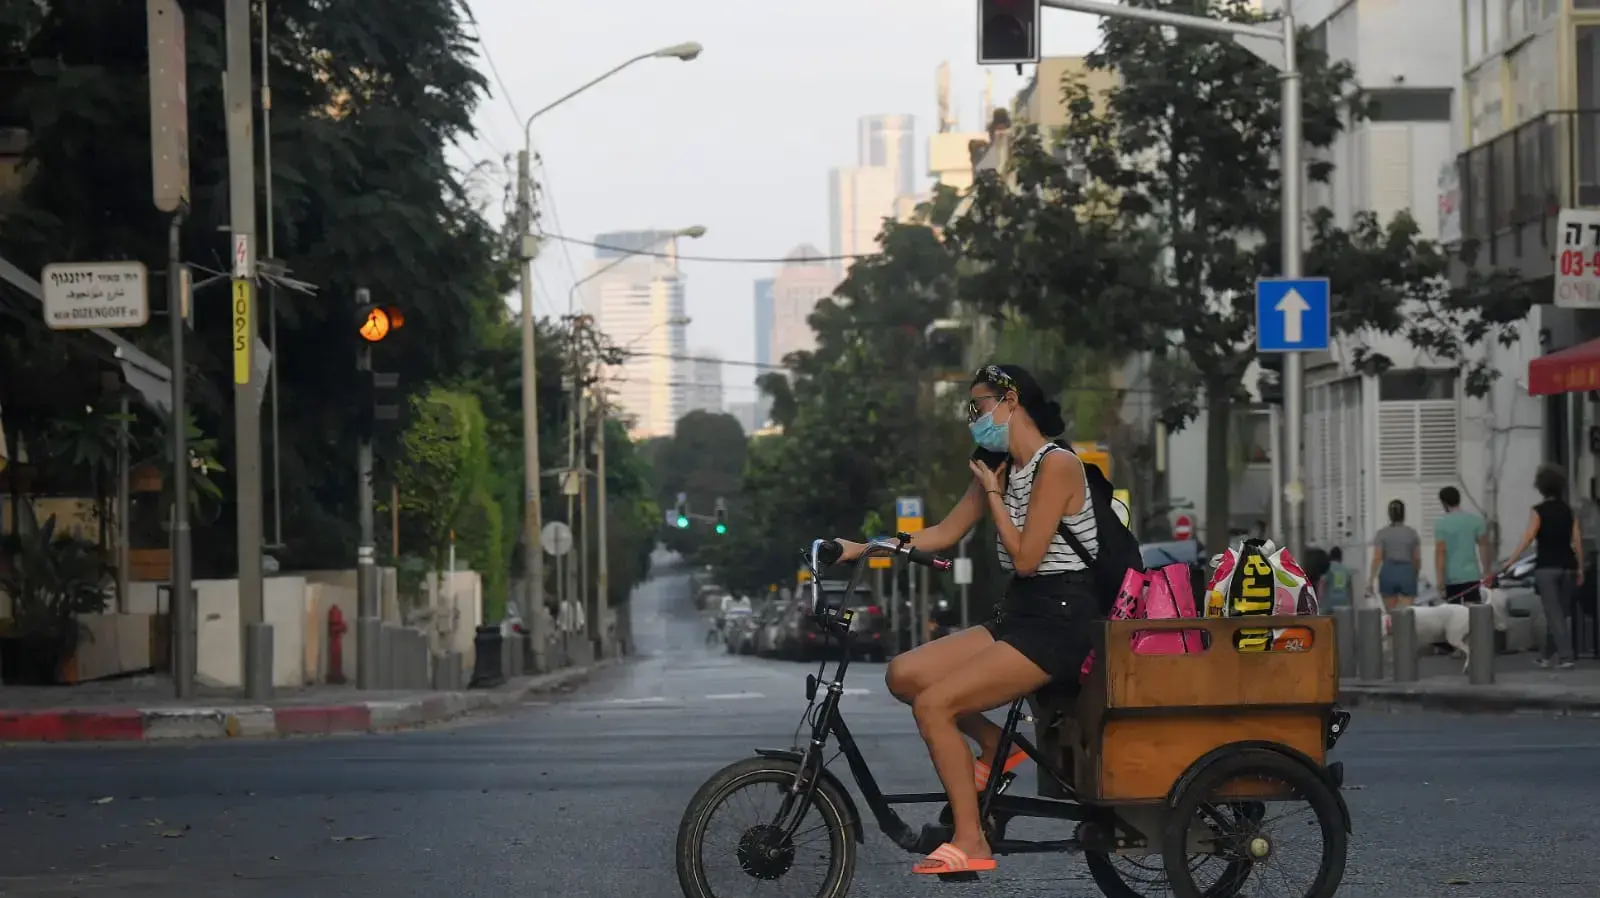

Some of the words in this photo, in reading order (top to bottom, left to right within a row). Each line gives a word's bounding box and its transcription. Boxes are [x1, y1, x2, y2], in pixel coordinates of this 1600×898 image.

[51, 272, 93, 287] דיזנגוף
[72, 306, 127, 319] DIZENGOFF
[235, 284, 246, 351] 1095
